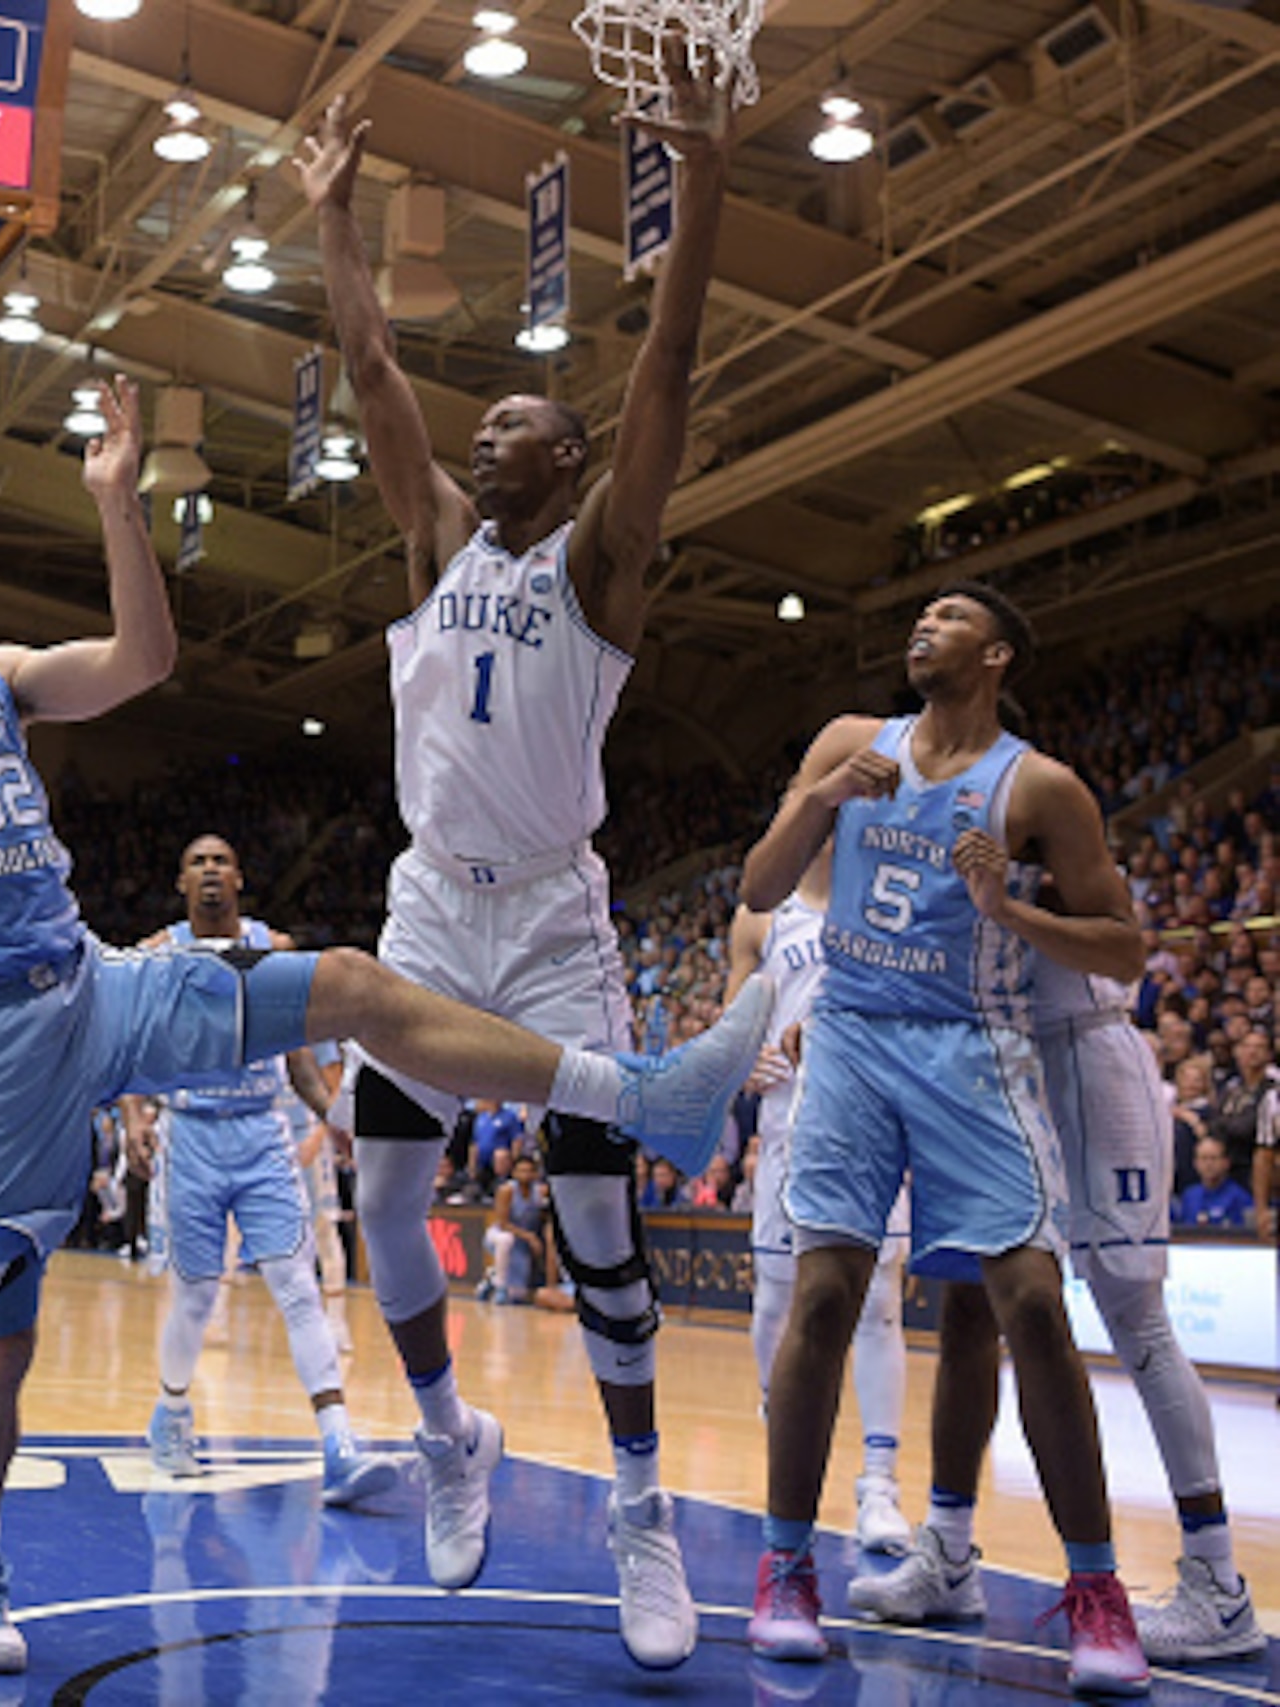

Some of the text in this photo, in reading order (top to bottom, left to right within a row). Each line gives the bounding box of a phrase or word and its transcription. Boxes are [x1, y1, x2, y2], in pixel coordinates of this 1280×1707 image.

[440, 592, 551, 648] DUKE
[470, 652, 494, 723] 1
[862, 825, 947, 871] NORTH
[864, 863, 921, 934] 5
[823, 924, 947, 974] CAROLINA
